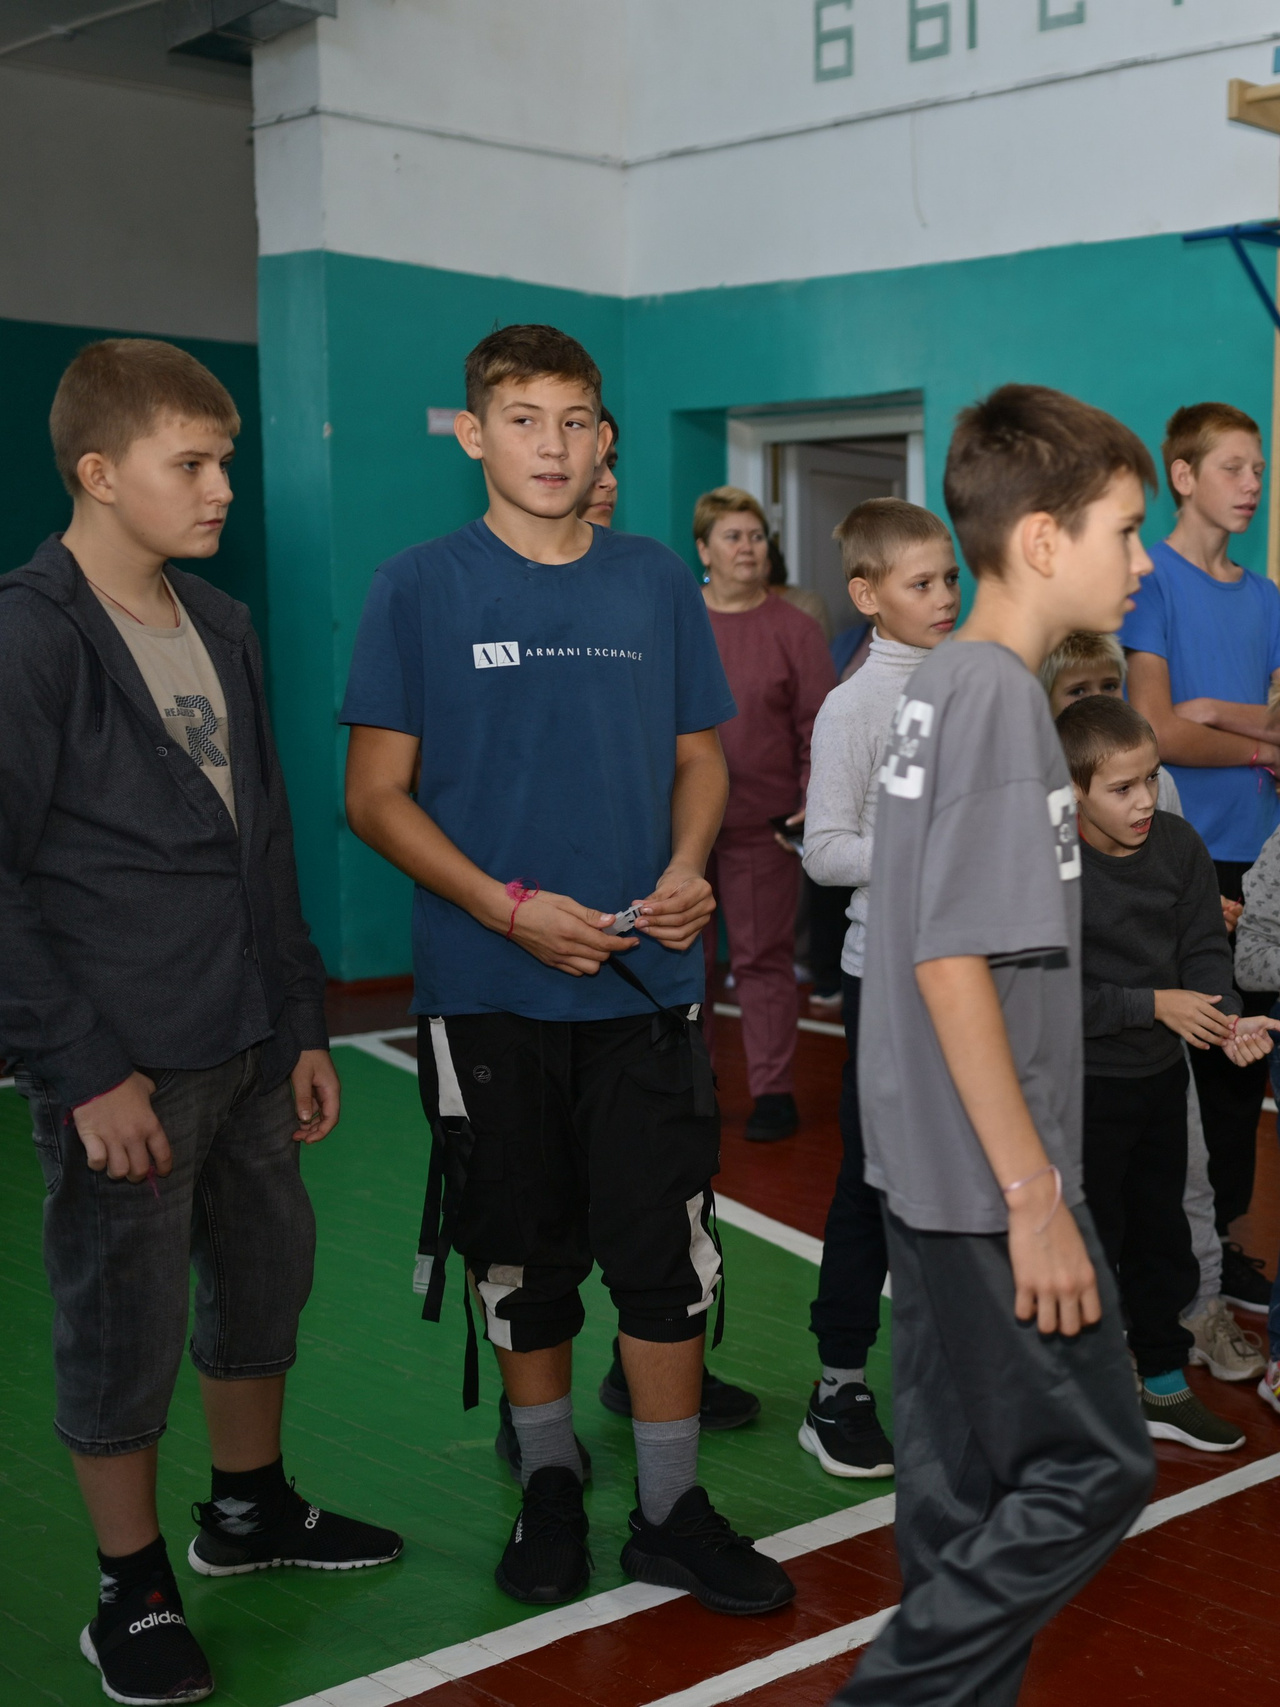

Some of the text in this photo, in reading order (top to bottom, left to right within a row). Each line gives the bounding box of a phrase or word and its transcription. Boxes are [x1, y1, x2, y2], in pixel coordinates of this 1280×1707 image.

[476, 643, 643, 667] AX ARMANI EXCHANGE
